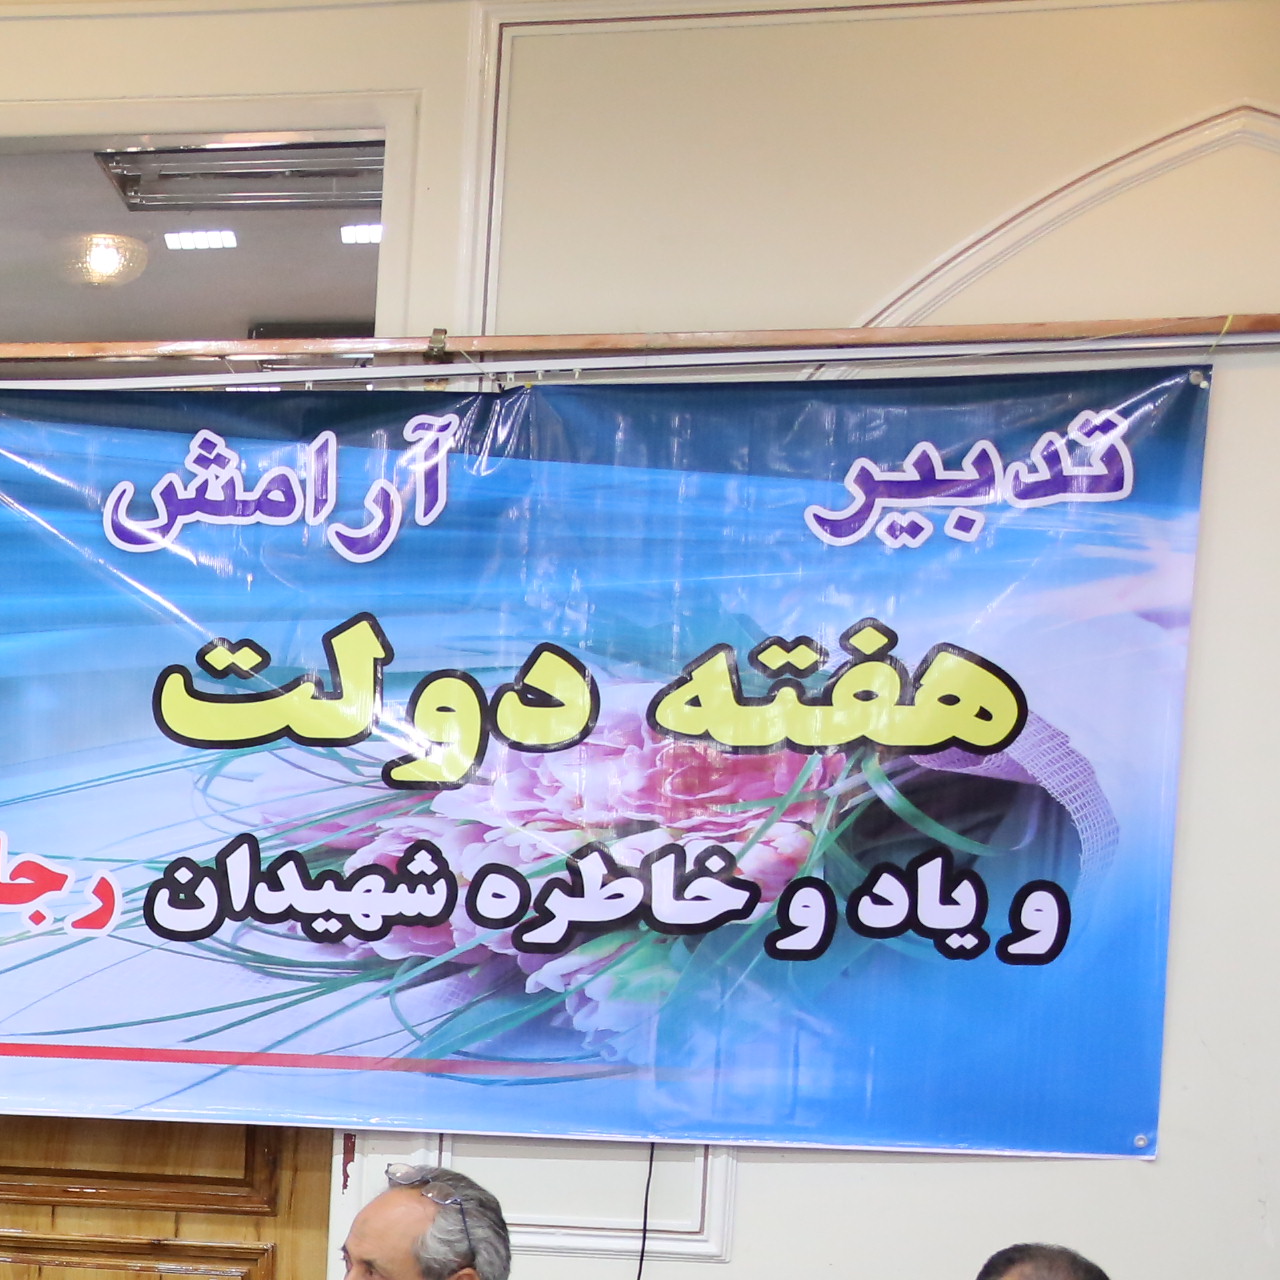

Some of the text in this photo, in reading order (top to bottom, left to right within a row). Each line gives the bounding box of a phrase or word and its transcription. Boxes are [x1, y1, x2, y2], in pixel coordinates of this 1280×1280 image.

[102, 413, 460, 563] آرامش
[804, 408, 1135, 549] تدبیر
[153, 610, 1029, 790] هفته دولت
[143, 832, 458, 943] شهیدان
[466, 840, 762, 957] خاطره
[764, 870, 837, 961] و
[846, 847, 989, 960] یاد
[995, 879, 1072, 966] و
